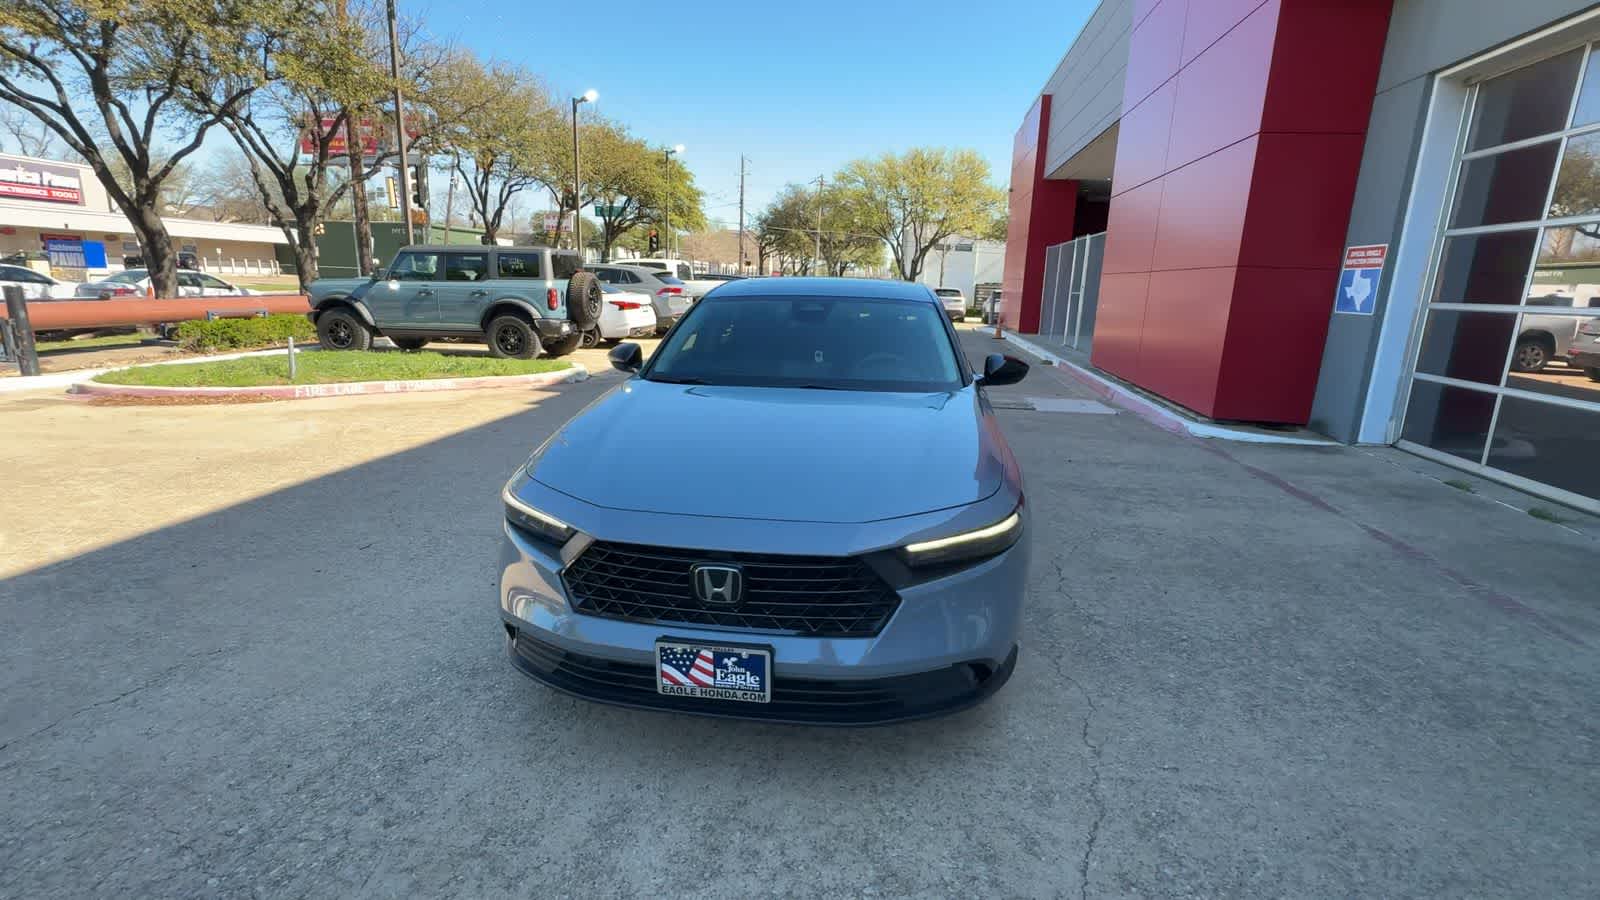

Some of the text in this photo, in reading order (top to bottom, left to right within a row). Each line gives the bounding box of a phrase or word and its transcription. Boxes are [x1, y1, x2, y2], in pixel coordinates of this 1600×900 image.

[295, 386, 326, 398] FIRE
[728, 664, 746, 673] John
[715, 668, 760, 687] Eagle
[662, 685, 767, 702] EAGLE HONDA.COM
